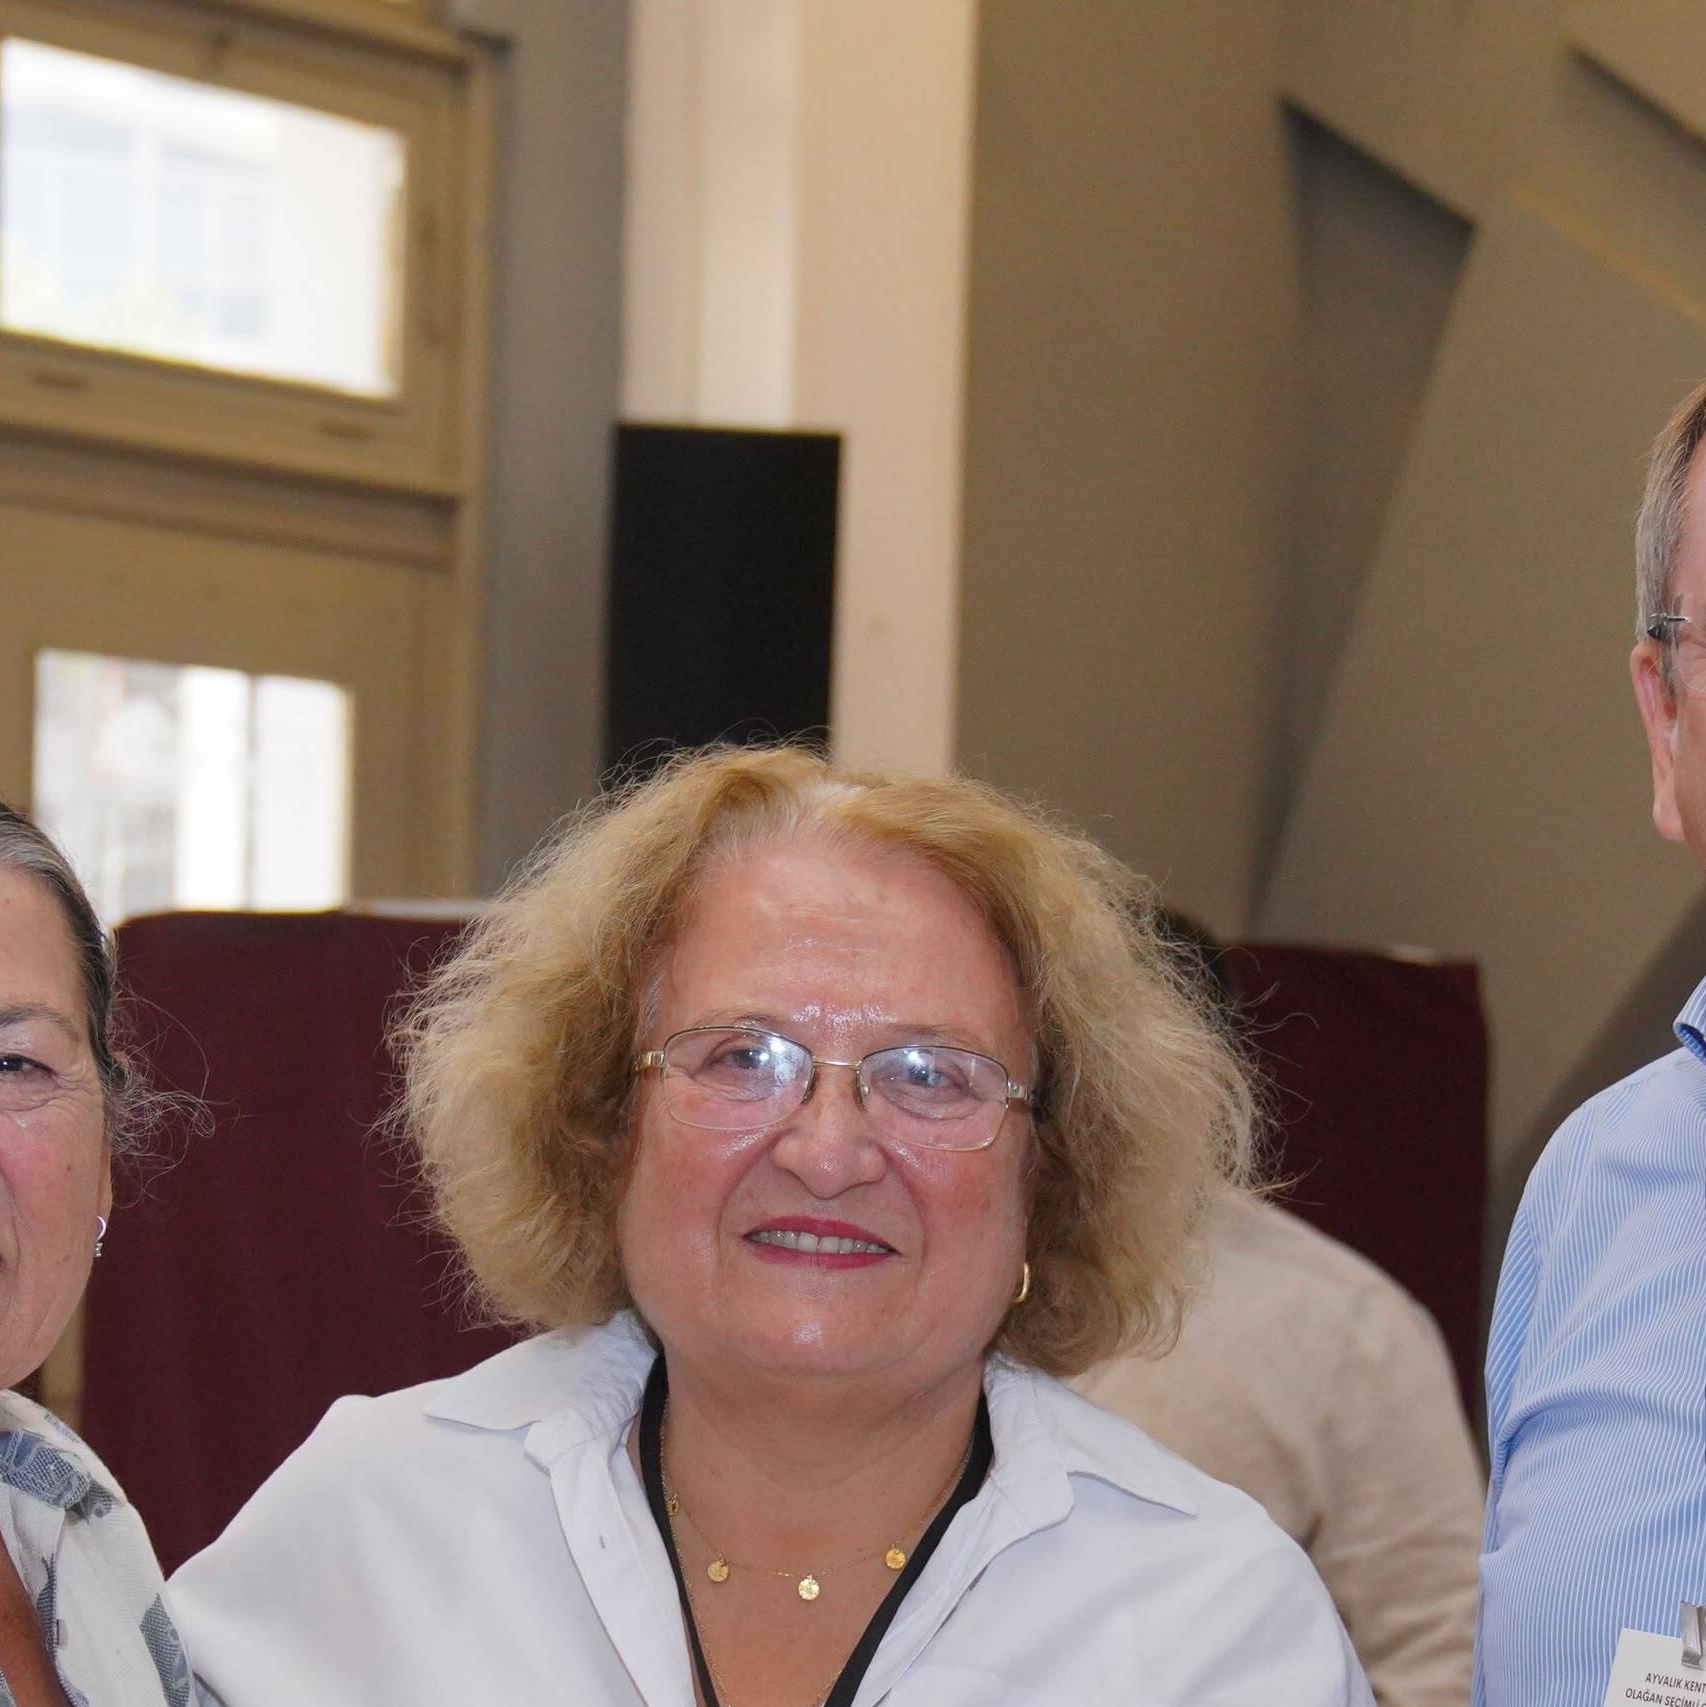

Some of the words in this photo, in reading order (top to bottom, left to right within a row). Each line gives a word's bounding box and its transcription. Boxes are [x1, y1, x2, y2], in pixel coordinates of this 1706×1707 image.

[1645, 1672, 1683, 1689] AYVALIK
[1683, 1680, 1706, 1694] KENT
[1625, 1687, 1663, 1704] OLAĞAN
